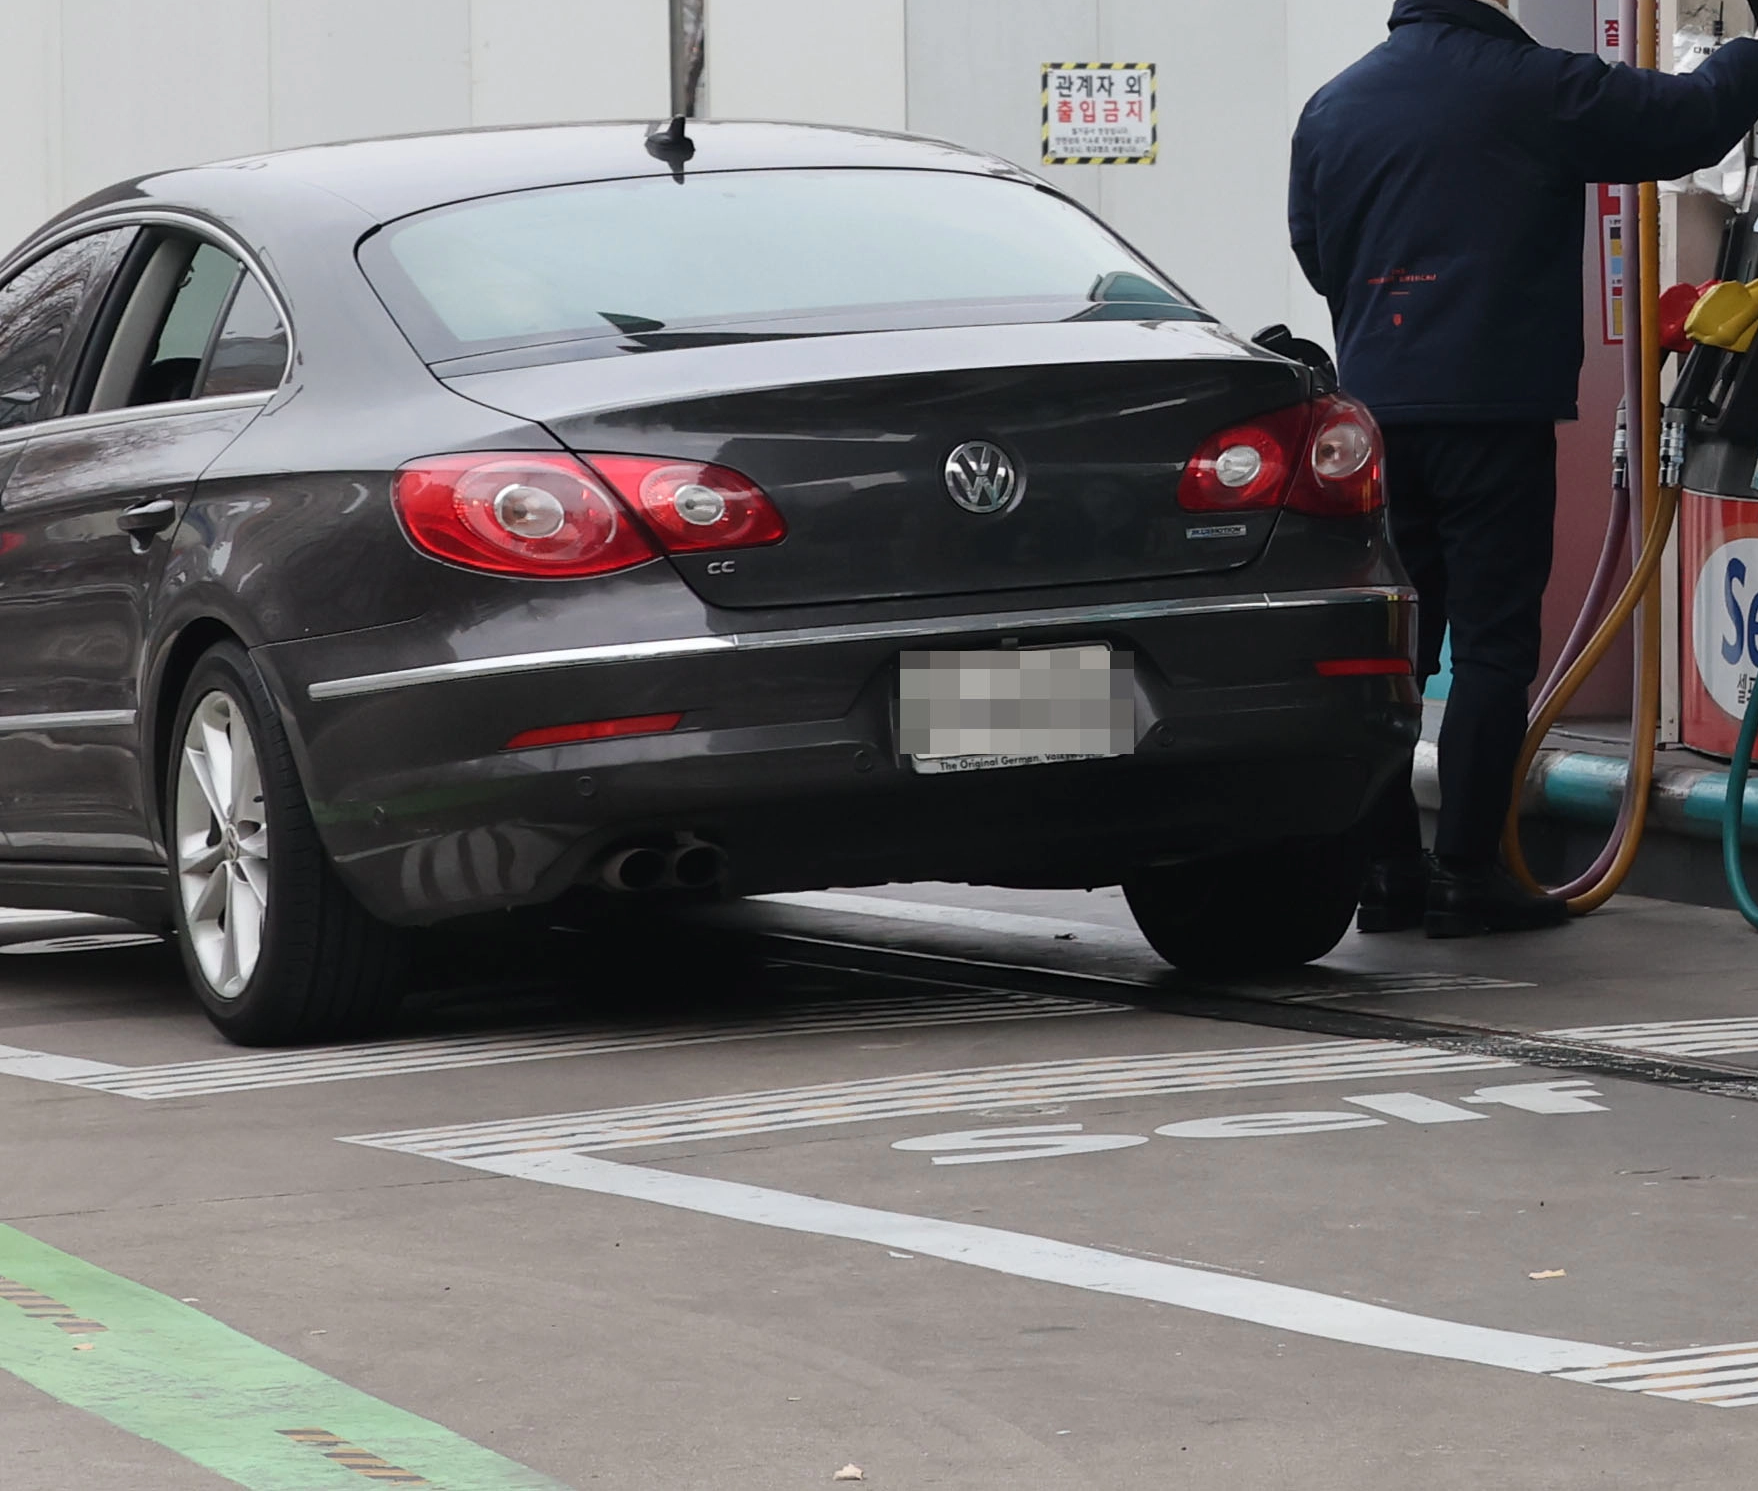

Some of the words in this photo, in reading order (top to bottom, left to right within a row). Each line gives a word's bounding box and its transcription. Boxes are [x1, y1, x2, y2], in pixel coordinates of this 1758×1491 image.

[1055, 74, 1115, 98] 관계자
[1124, 74, 1142, 98] 외
[1055, 99, 1143, 123] 출입금지
[707, 560, 735, 575] CC
[940, 762, 957, 771] The
[960, 757, 999, 770] Original
[891, 1080, 1611, 1165] Self
